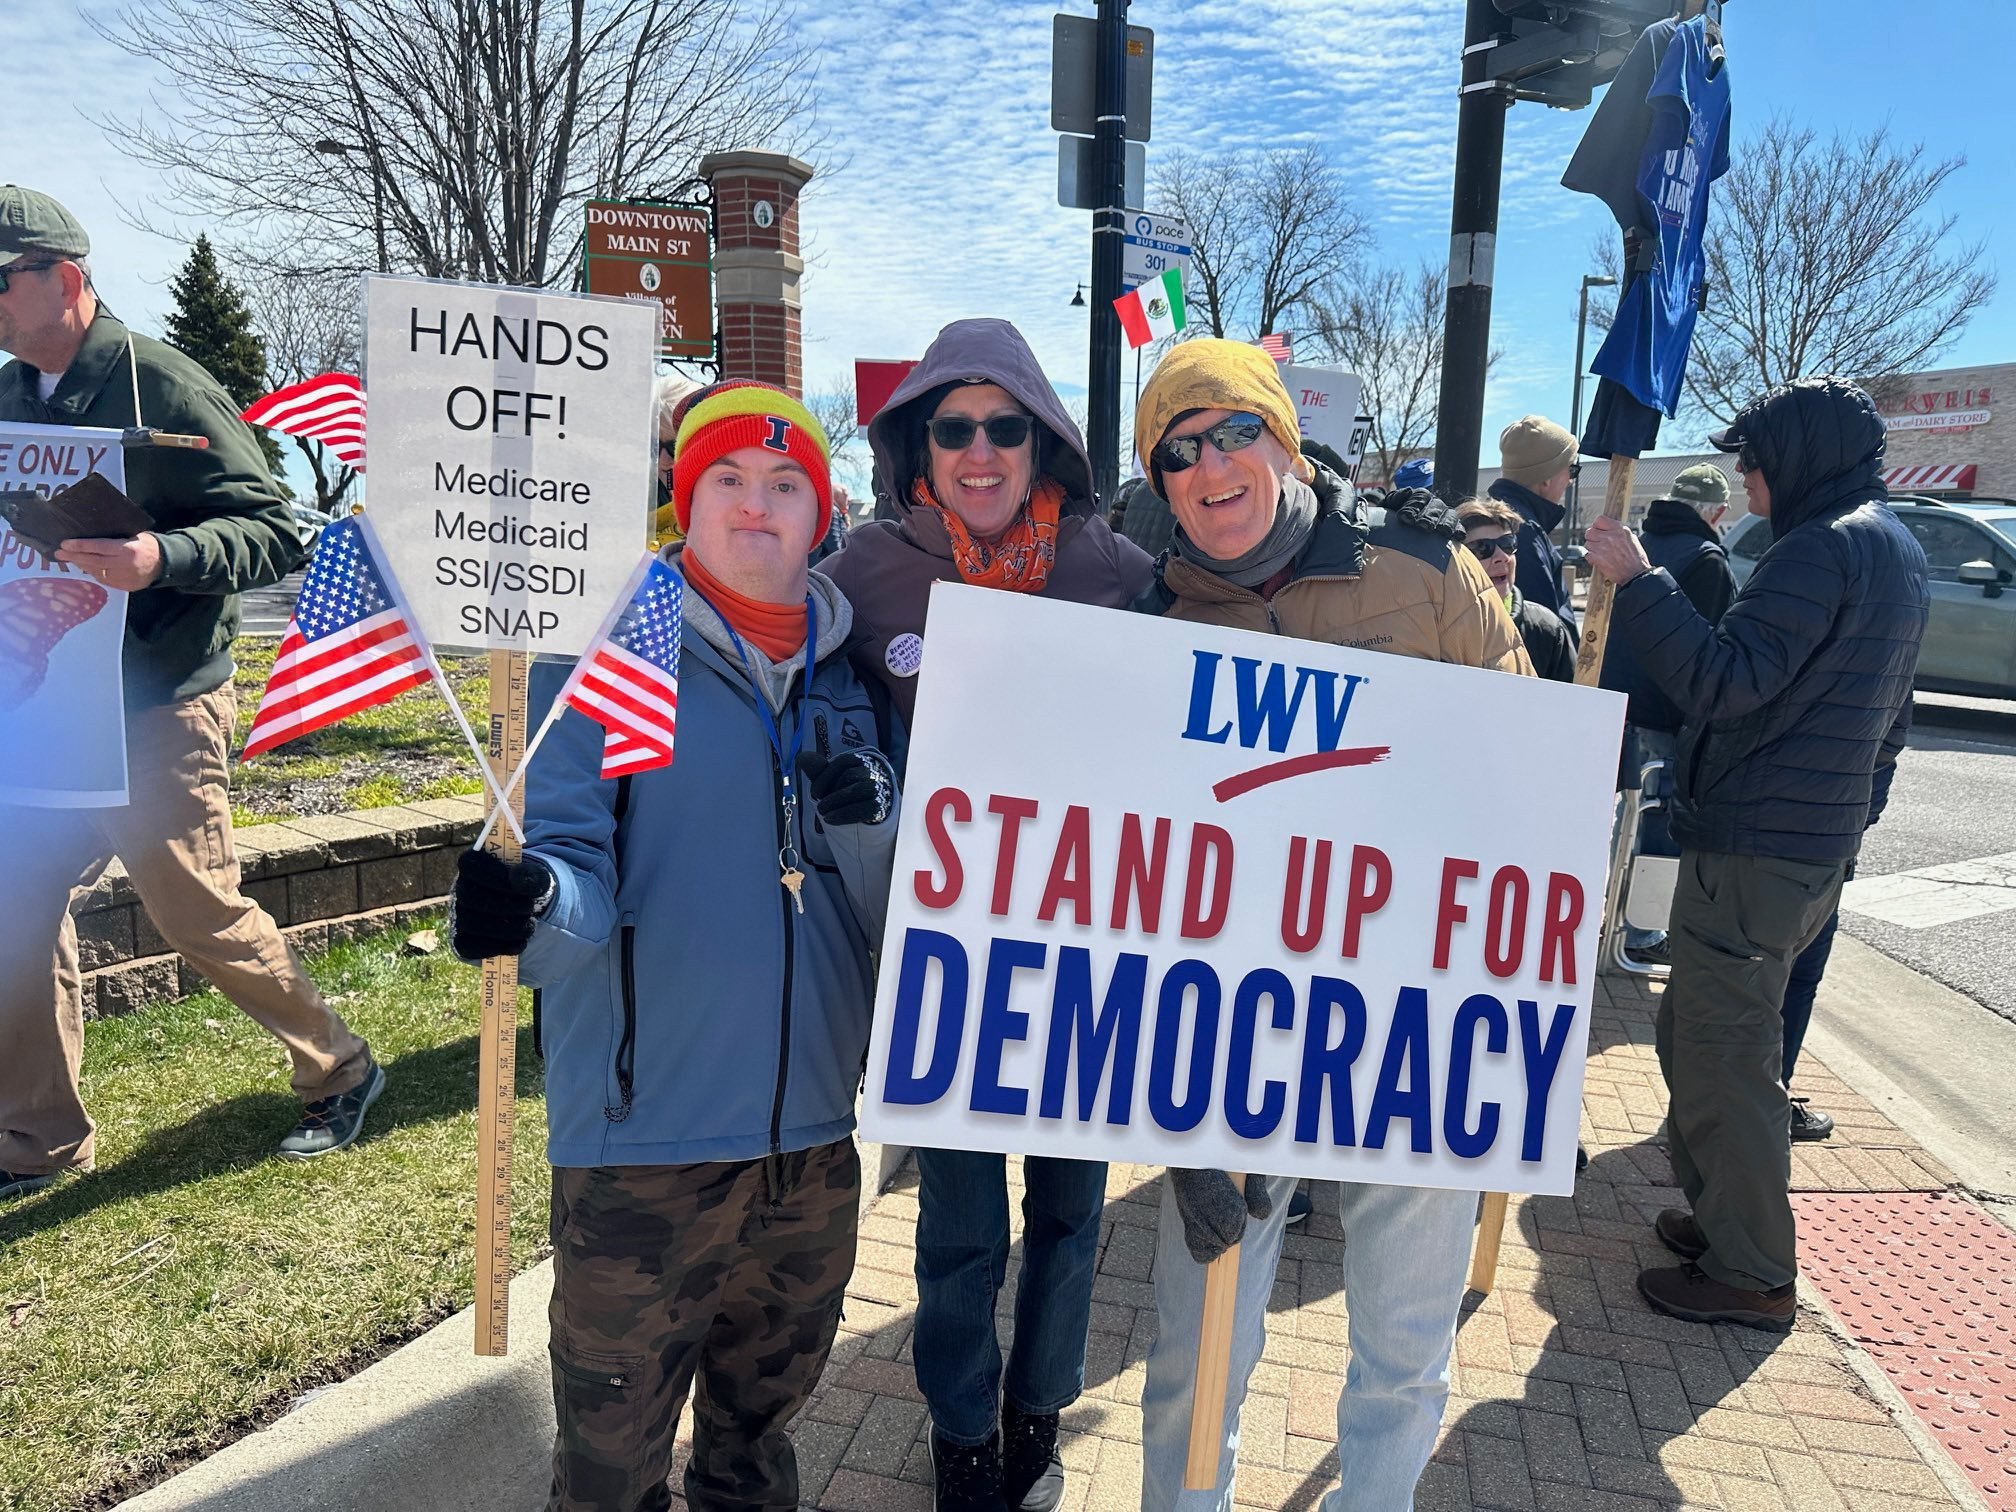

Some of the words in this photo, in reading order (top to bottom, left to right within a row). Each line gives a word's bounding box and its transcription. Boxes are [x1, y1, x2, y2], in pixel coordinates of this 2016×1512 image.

[588, 208, 707, 233] DOWNTOWN
[1155, 225, 1184, 239] pace
[607, 234, 660, 253] MAIN
[667, 239, 691, 256] ST
[1136, 238, 1154, 247] BUS
[1156, 242, 1180, 252] STOP
[1145, 254, 1166, 271] 301
[665, 295, 677, 305] of
[410, 307, 610, 371] HANDS
[1300, 389, 1330, 407] THE
[446, 385, 566, 440] OFF!
[1914, 415, 1947, 427] DAIRY
[1949, 412, 1988, 425] STORE
[18, 444, 107, 476] ONLY
[434, 462, 591, 504] Medicare
[434, 509, 588, 551] Medicaid
[435, 556, 585, 596] SSI/SSDI
[459, 604, 559, 640] SNAP
[888, 655, 898, 664] ME
[898, 638, 920, 656] WHEN
[890, 635, 913, 655] REMIND
[1341, 634, 1393, 648] Columbia
[914, 787, 1234, 939] STAND
[1281, 836, 1392, 958] UP
[1433, 858, 1584, 985] FOR
[883, 928, 1577, 1162] DEMOCRACY
